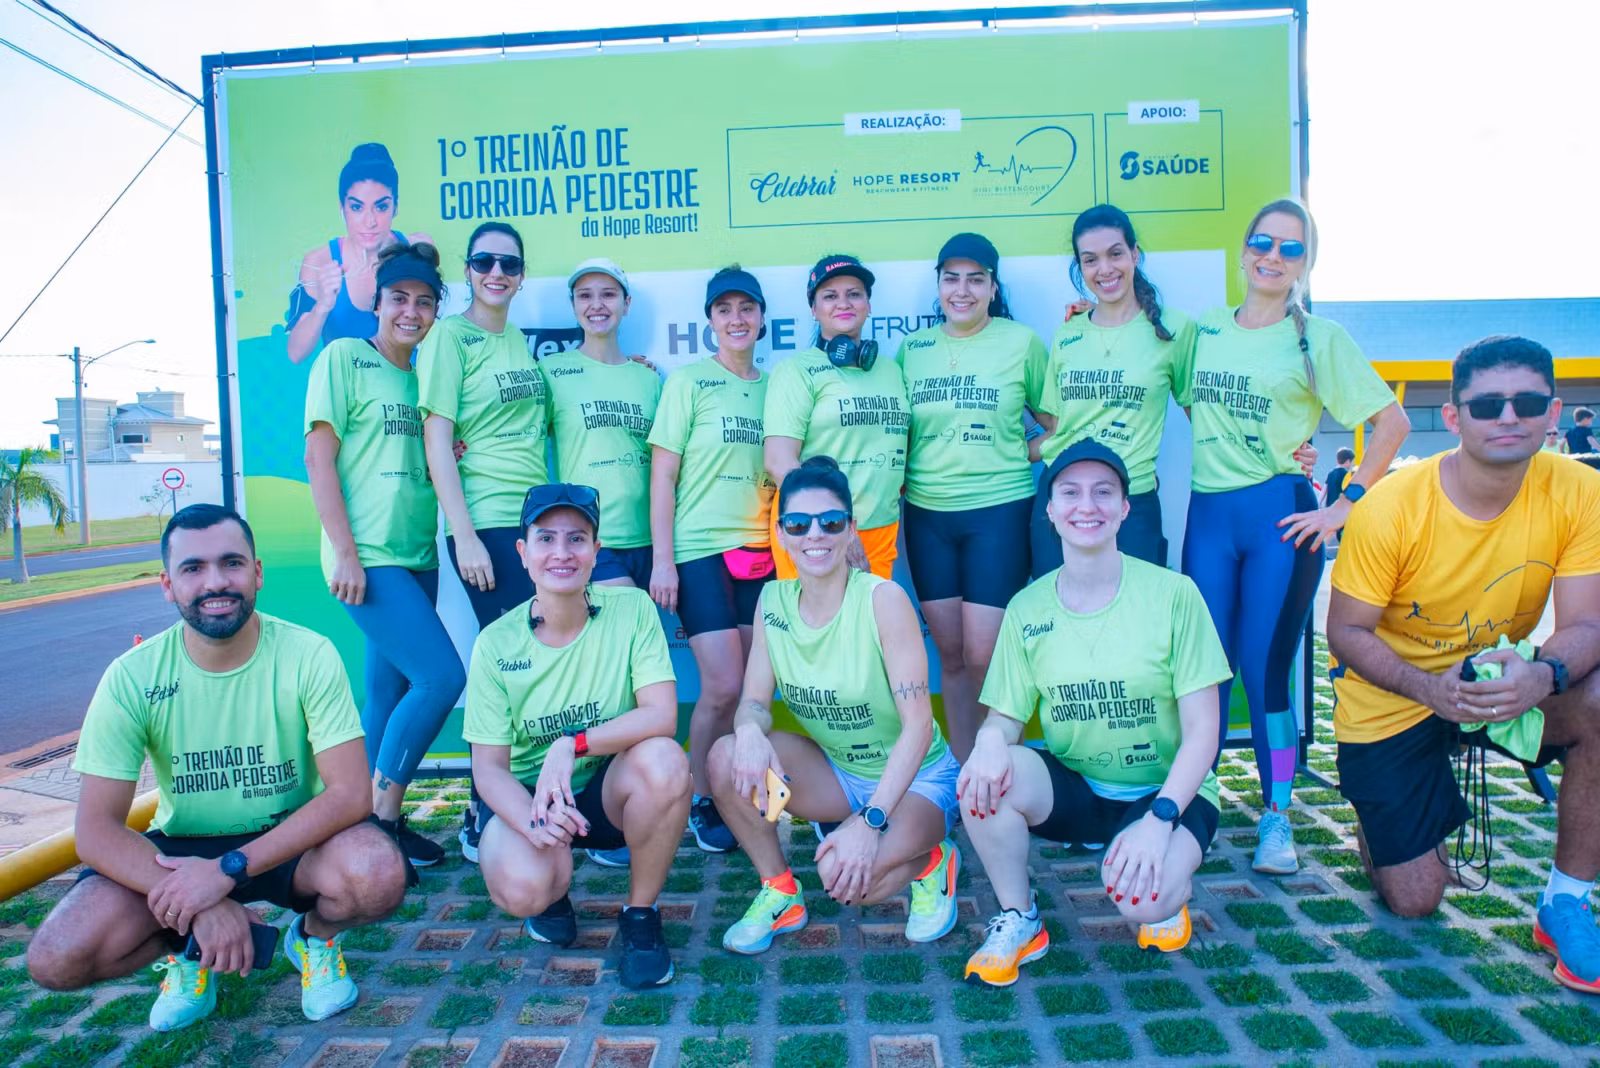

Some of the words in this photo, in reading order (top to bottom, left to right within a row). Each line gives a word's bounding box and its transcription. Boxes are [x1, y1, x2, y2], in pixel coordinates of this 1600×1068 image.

[860, 113, 946, 130] REALIZAÇÃO:
[1140, 106, 1187, 119] APOIO:
[474, 124, 587, 174] TREINÃO
[595, 127, 630, 168] DE
[1142, 153, 1210, 176] SAÚDE
[750, 171, 837, 204] Celebrar
[852, 175, 895, 187] HOPE
[899, 172, 961, 185] RESORT
[440, 176, 558, 221] CORRIDA
[565, 168, 700, 214] PEDESTRE
[581, 216, 599, 238] da
[603, 215, 641, 239] Hope
[645, 212, 699, 235] Resort!
[835, 342, 848, 360] JBL
[550, 367, 585, 379] Celebrar
[923, 375, 962, 388] TREINÃO
[963, 374, 977, 387] DE
[1069, 368, 1109, 385] TREINÃO
[1110, 369, 1125, 384] DE
[1196, 370, 1235, 390] TREINÃO
[1236, 375, 1252, 392] DE
[499, 384, 533, 404] CORRIDA
[911, 389, 948, 407] CORRIDA
[950, 387, 1000, 403] PEDESTRE
[1061, 385, 1098, 402] CORRIDA
[1099, 384, 1148, 402] PEDESTRE
[593, 400, 631, 416] TREINÃO
[631, 403, 644, 416] DE
[852, 395, 889, 411] TREINÃO
[889, 396, 901, 411] DE
[962, 401, 977, 411] Hope
[1223, 390, 1273, 415] PEDESTRE
[584, 413, 623, 431] CORRIDA
[840, 411, 880, 427] CORRIDA
[384, 419, 420, 438] CORRIDA
[723, 429, 761, 446] CORRIDA
[969, 432, 992, 441] SAÚDE
[785, 683, 824, 706] TREINÃO
[824, 689, 841, 706] DE
[1057, 679, 1107, 702] TREINÃO
[1109, 680, 1127, 699] DE
[585, 701, 601, 720] DE
[816, 702, 873, 722] PEDESTRE
[1099, 696, 1157, 719] PEDESTRE
[1118, 718, 1136, 730] Hope
[183, 745, 243, 772] TREINÃO
[247, 744, 266, 766] DE
[1134, 753, 1159, 763] SAÚD
[232, 758, 299, 788] PEDESTRE
[253, 786, 273, 799] Hope
